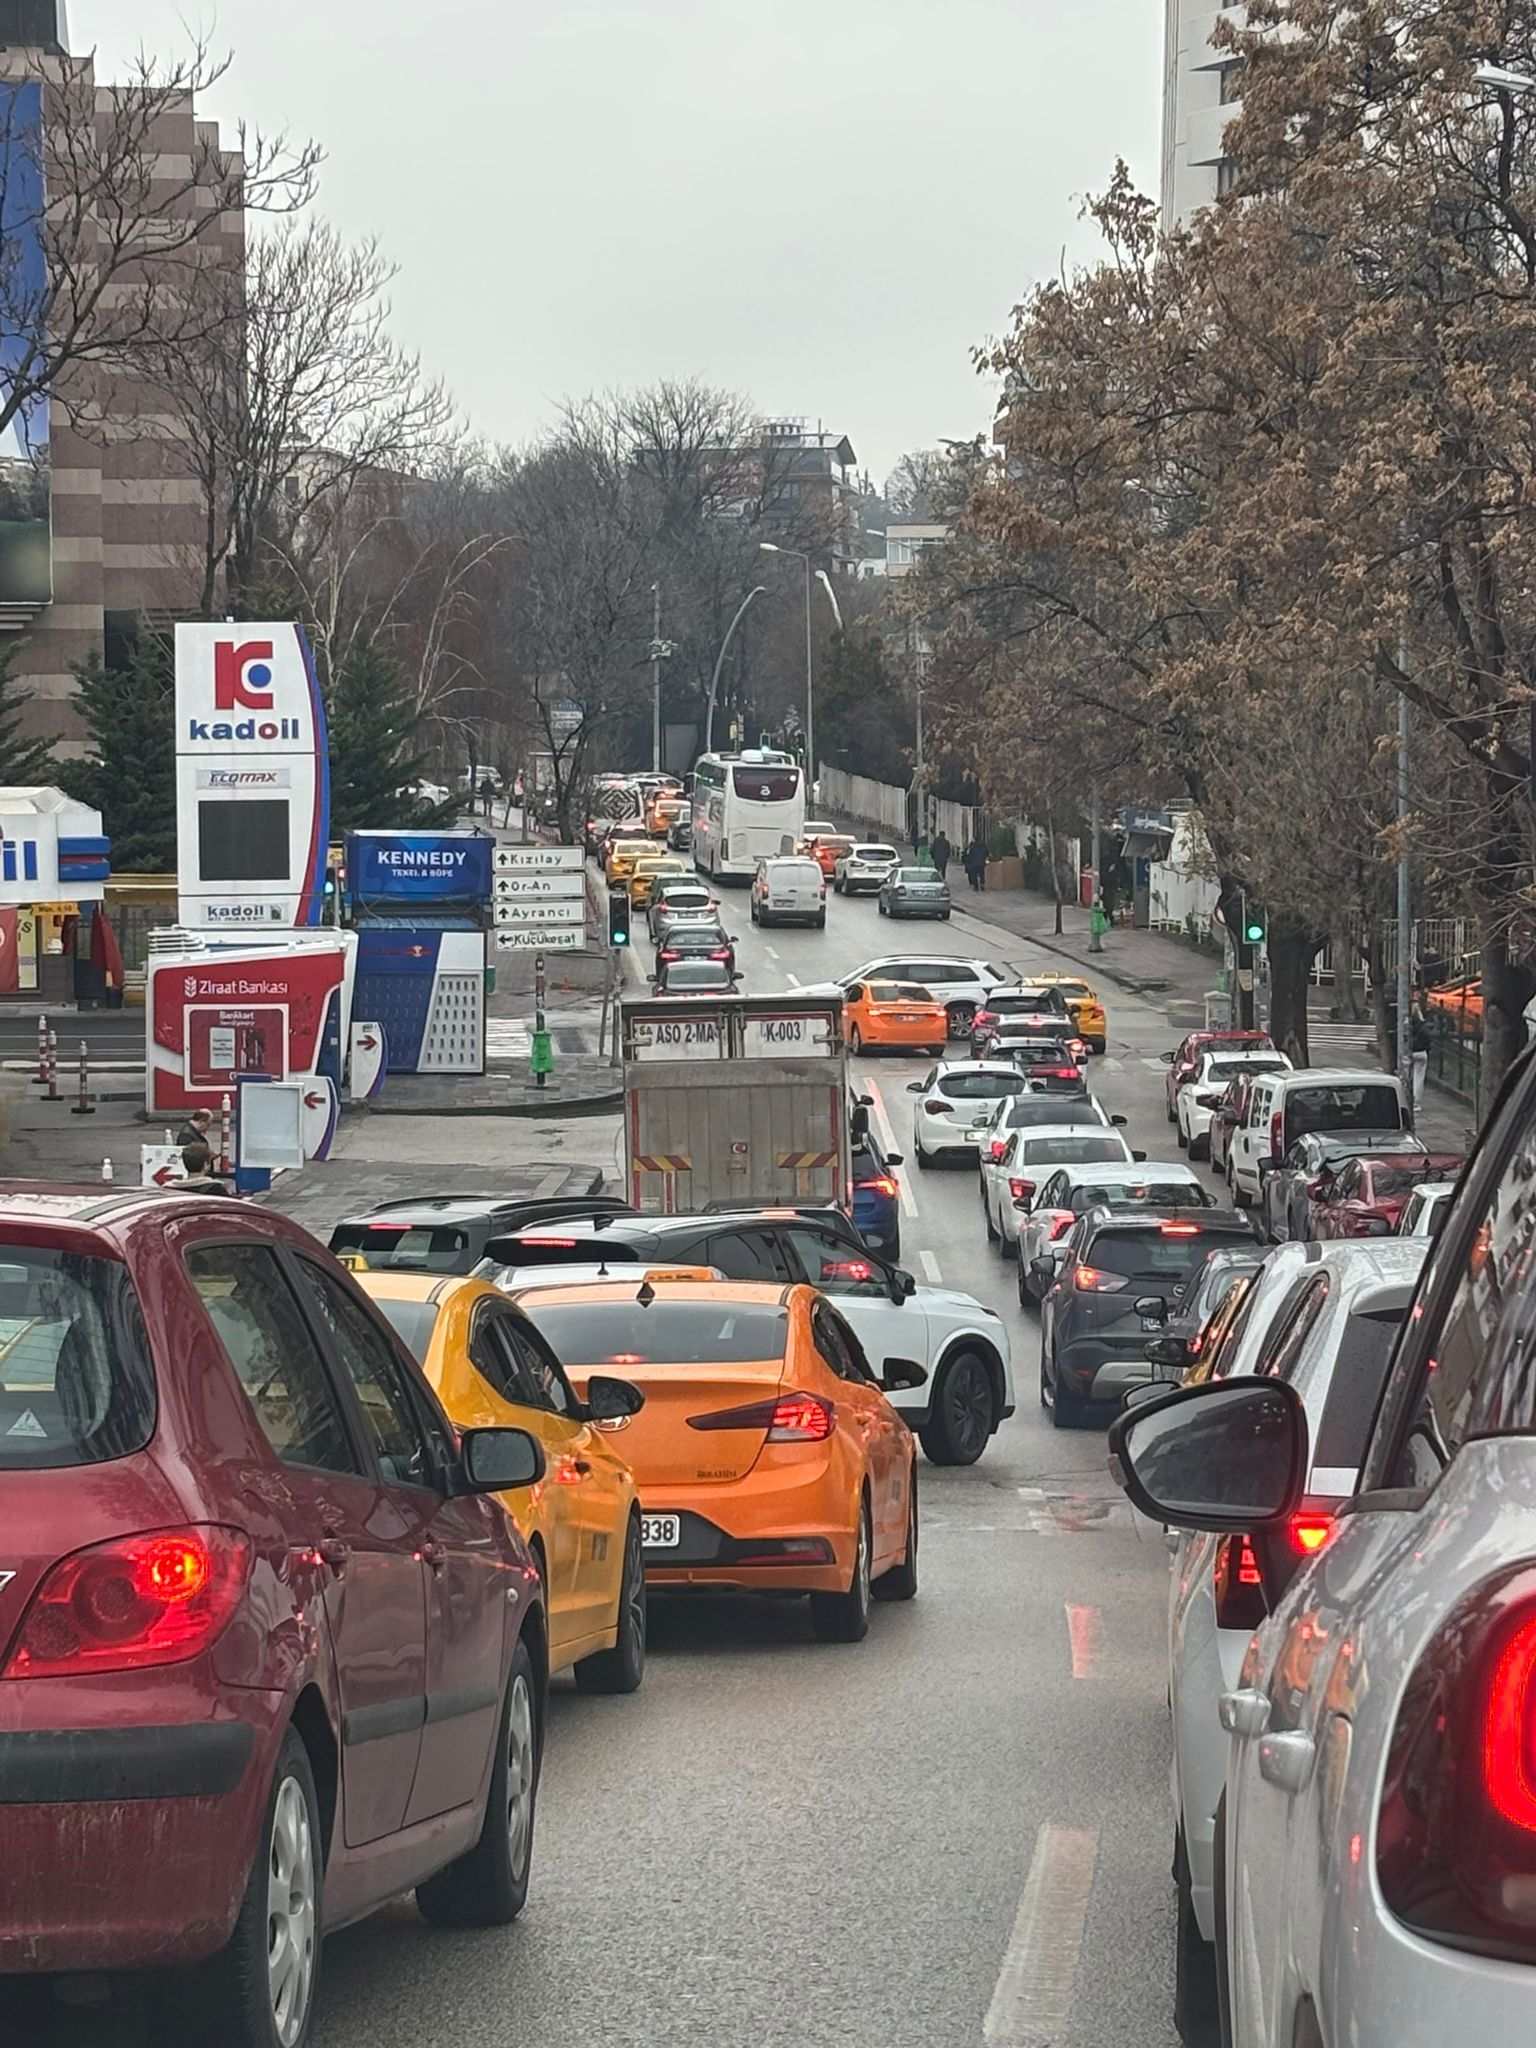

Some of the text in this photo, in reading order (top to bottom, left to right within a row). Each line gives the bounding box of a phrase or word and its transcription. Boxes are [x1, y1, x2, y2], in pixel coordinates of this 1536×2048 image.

[190, 719, 299, 740] kadoil
[378, 851, 466, 865] KENNEDY
[510, 854, 562, 865] Kızılay
[511, 881, 551, 891] Or-An
[208, 905, 264, 917] kadoil
[512, 908, 570, 919] Ayrancı
[199, 980, 288, 994] Ziraat Bankası
[656, 1024, 681, 1043] ASO
